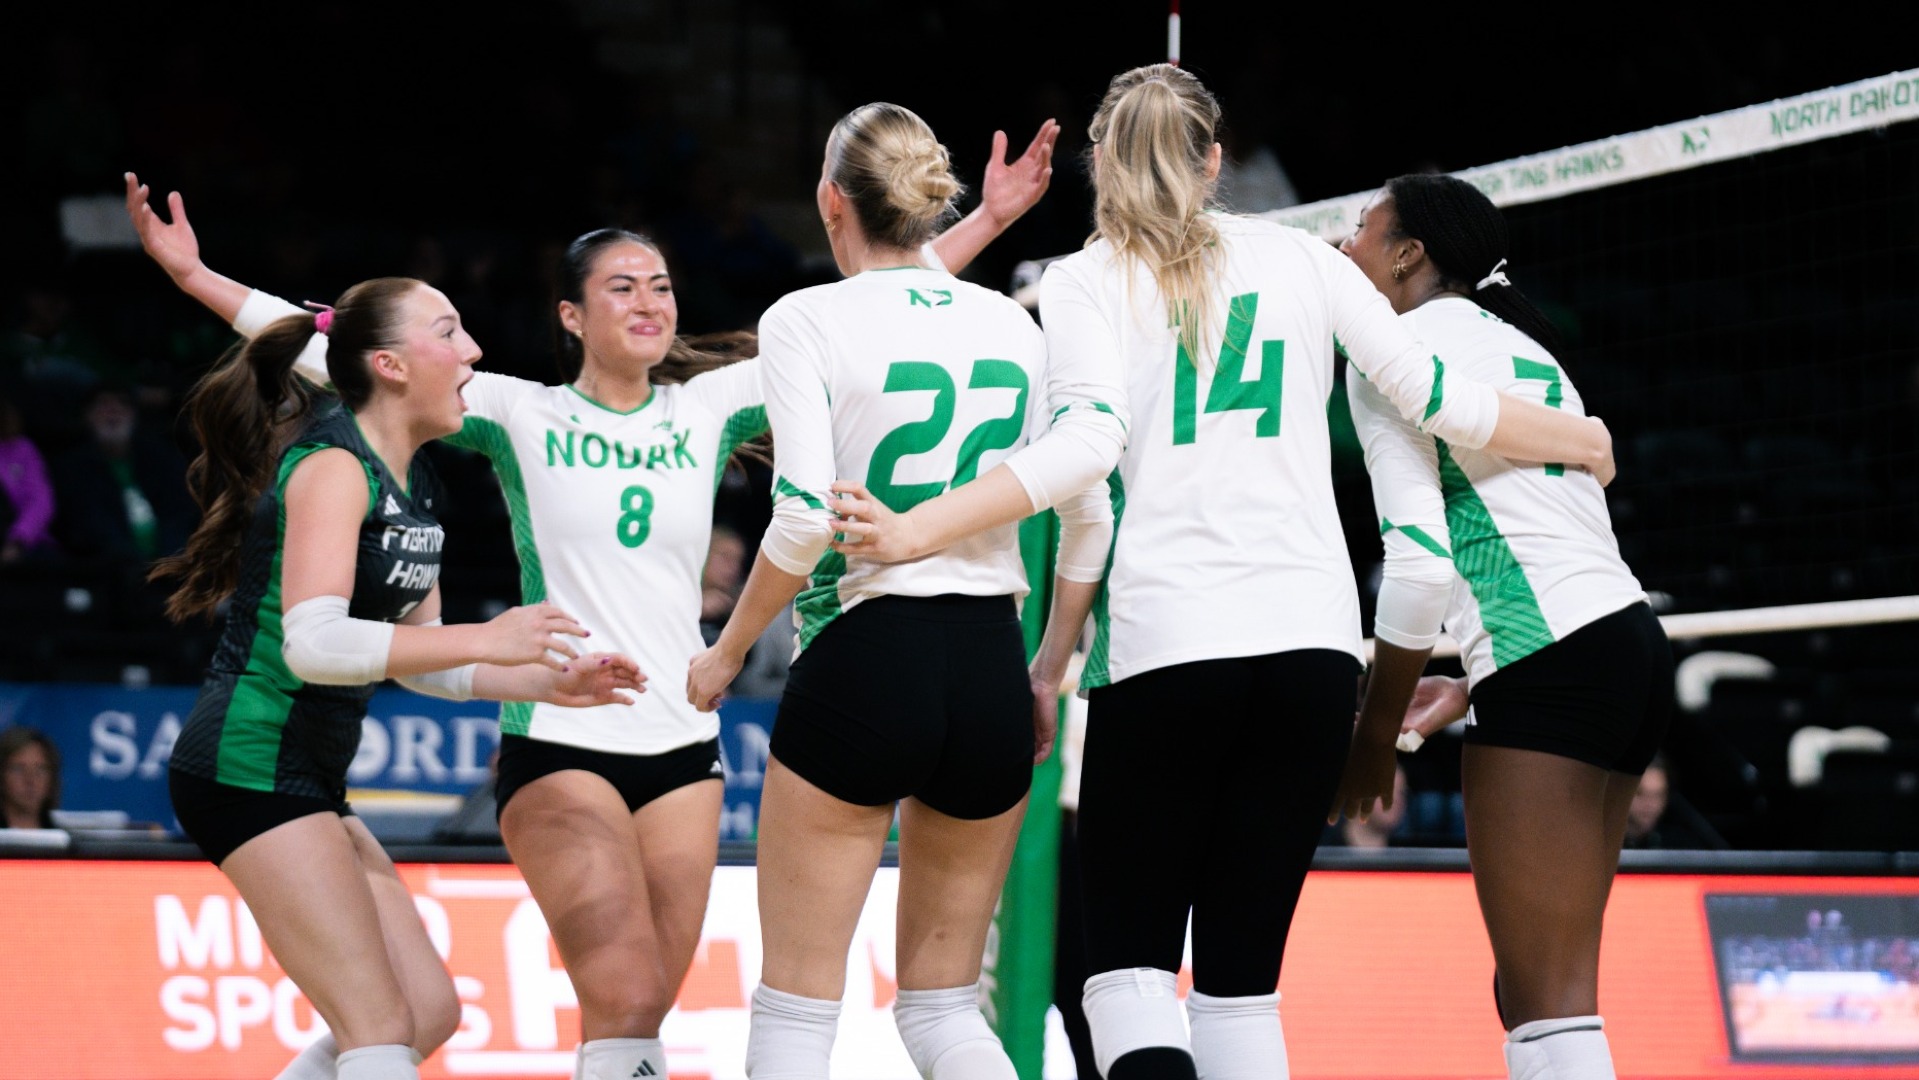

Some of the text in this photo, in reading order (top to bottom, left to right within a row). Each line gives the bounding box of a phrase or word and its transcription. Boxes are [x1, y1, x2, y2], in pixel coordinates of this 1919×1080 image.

[1769, 96, 1842, 138] NORTH
[1167, 291, 1285, 446] 14
[546, 428, 698, 470] NODAK
[866, 359, 1029, 514] 22
[1511, 355, 1565, 477] 7
[616, 484, 655, 548] 8
[159, 975, 492, 1053] SPOS
